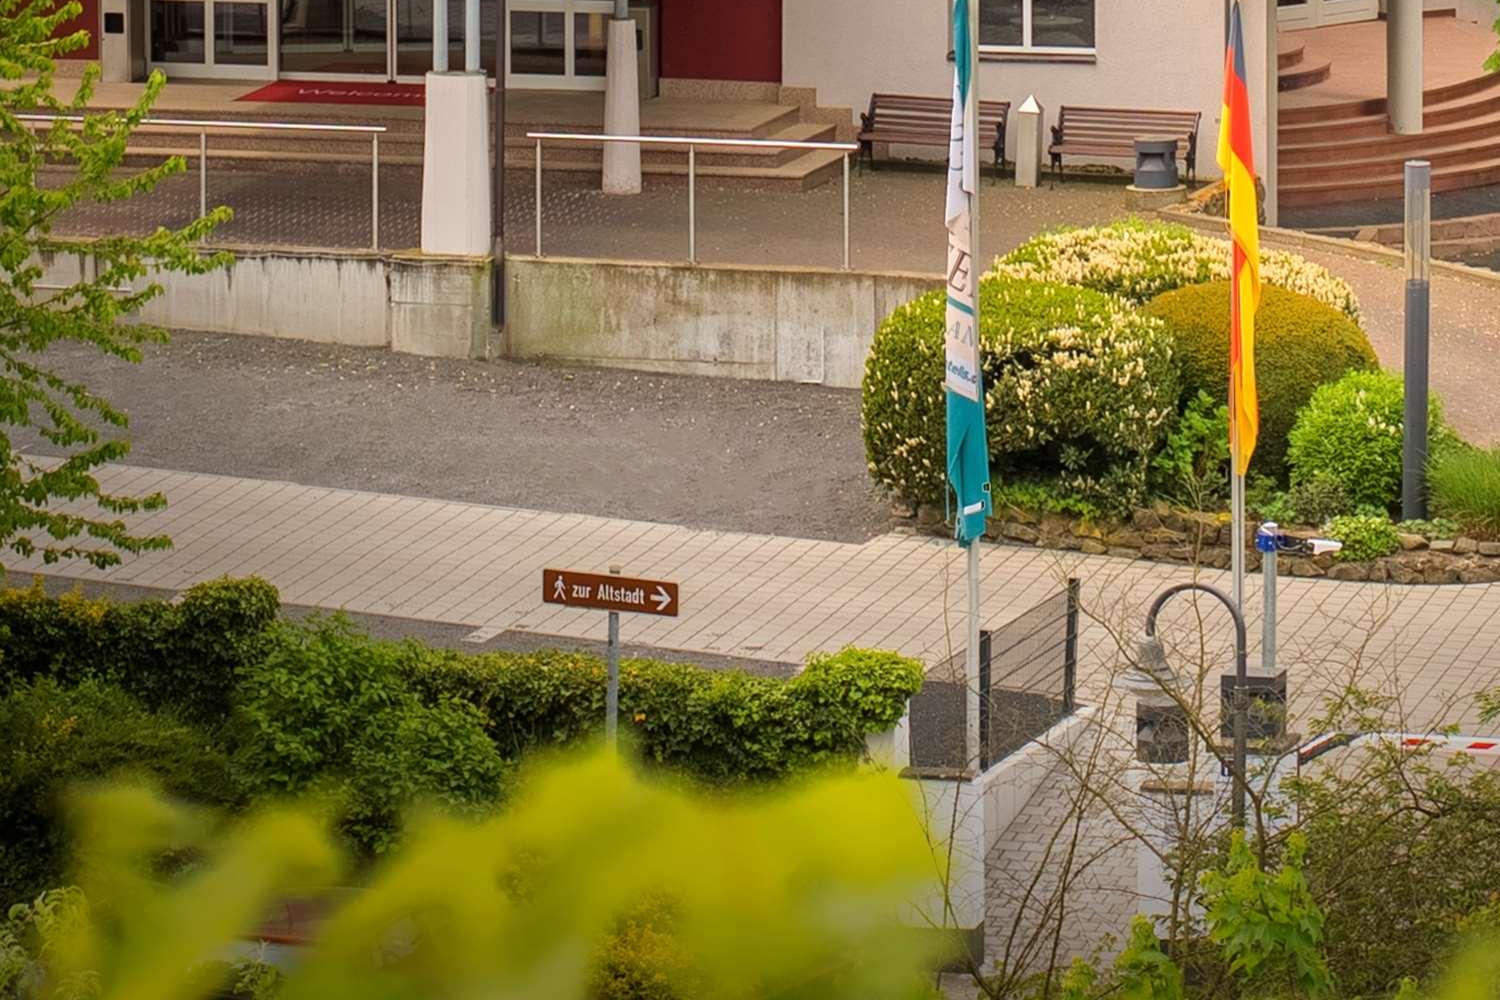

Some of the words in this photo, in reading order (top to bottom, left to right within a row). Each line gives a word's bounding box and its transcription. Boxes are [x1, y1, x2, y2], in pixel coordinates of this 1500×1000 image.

[298, 88, 425, 99] Welcom
[572, 584, 591, 598] zur
[597, 583, 645, 605] Altstadt
